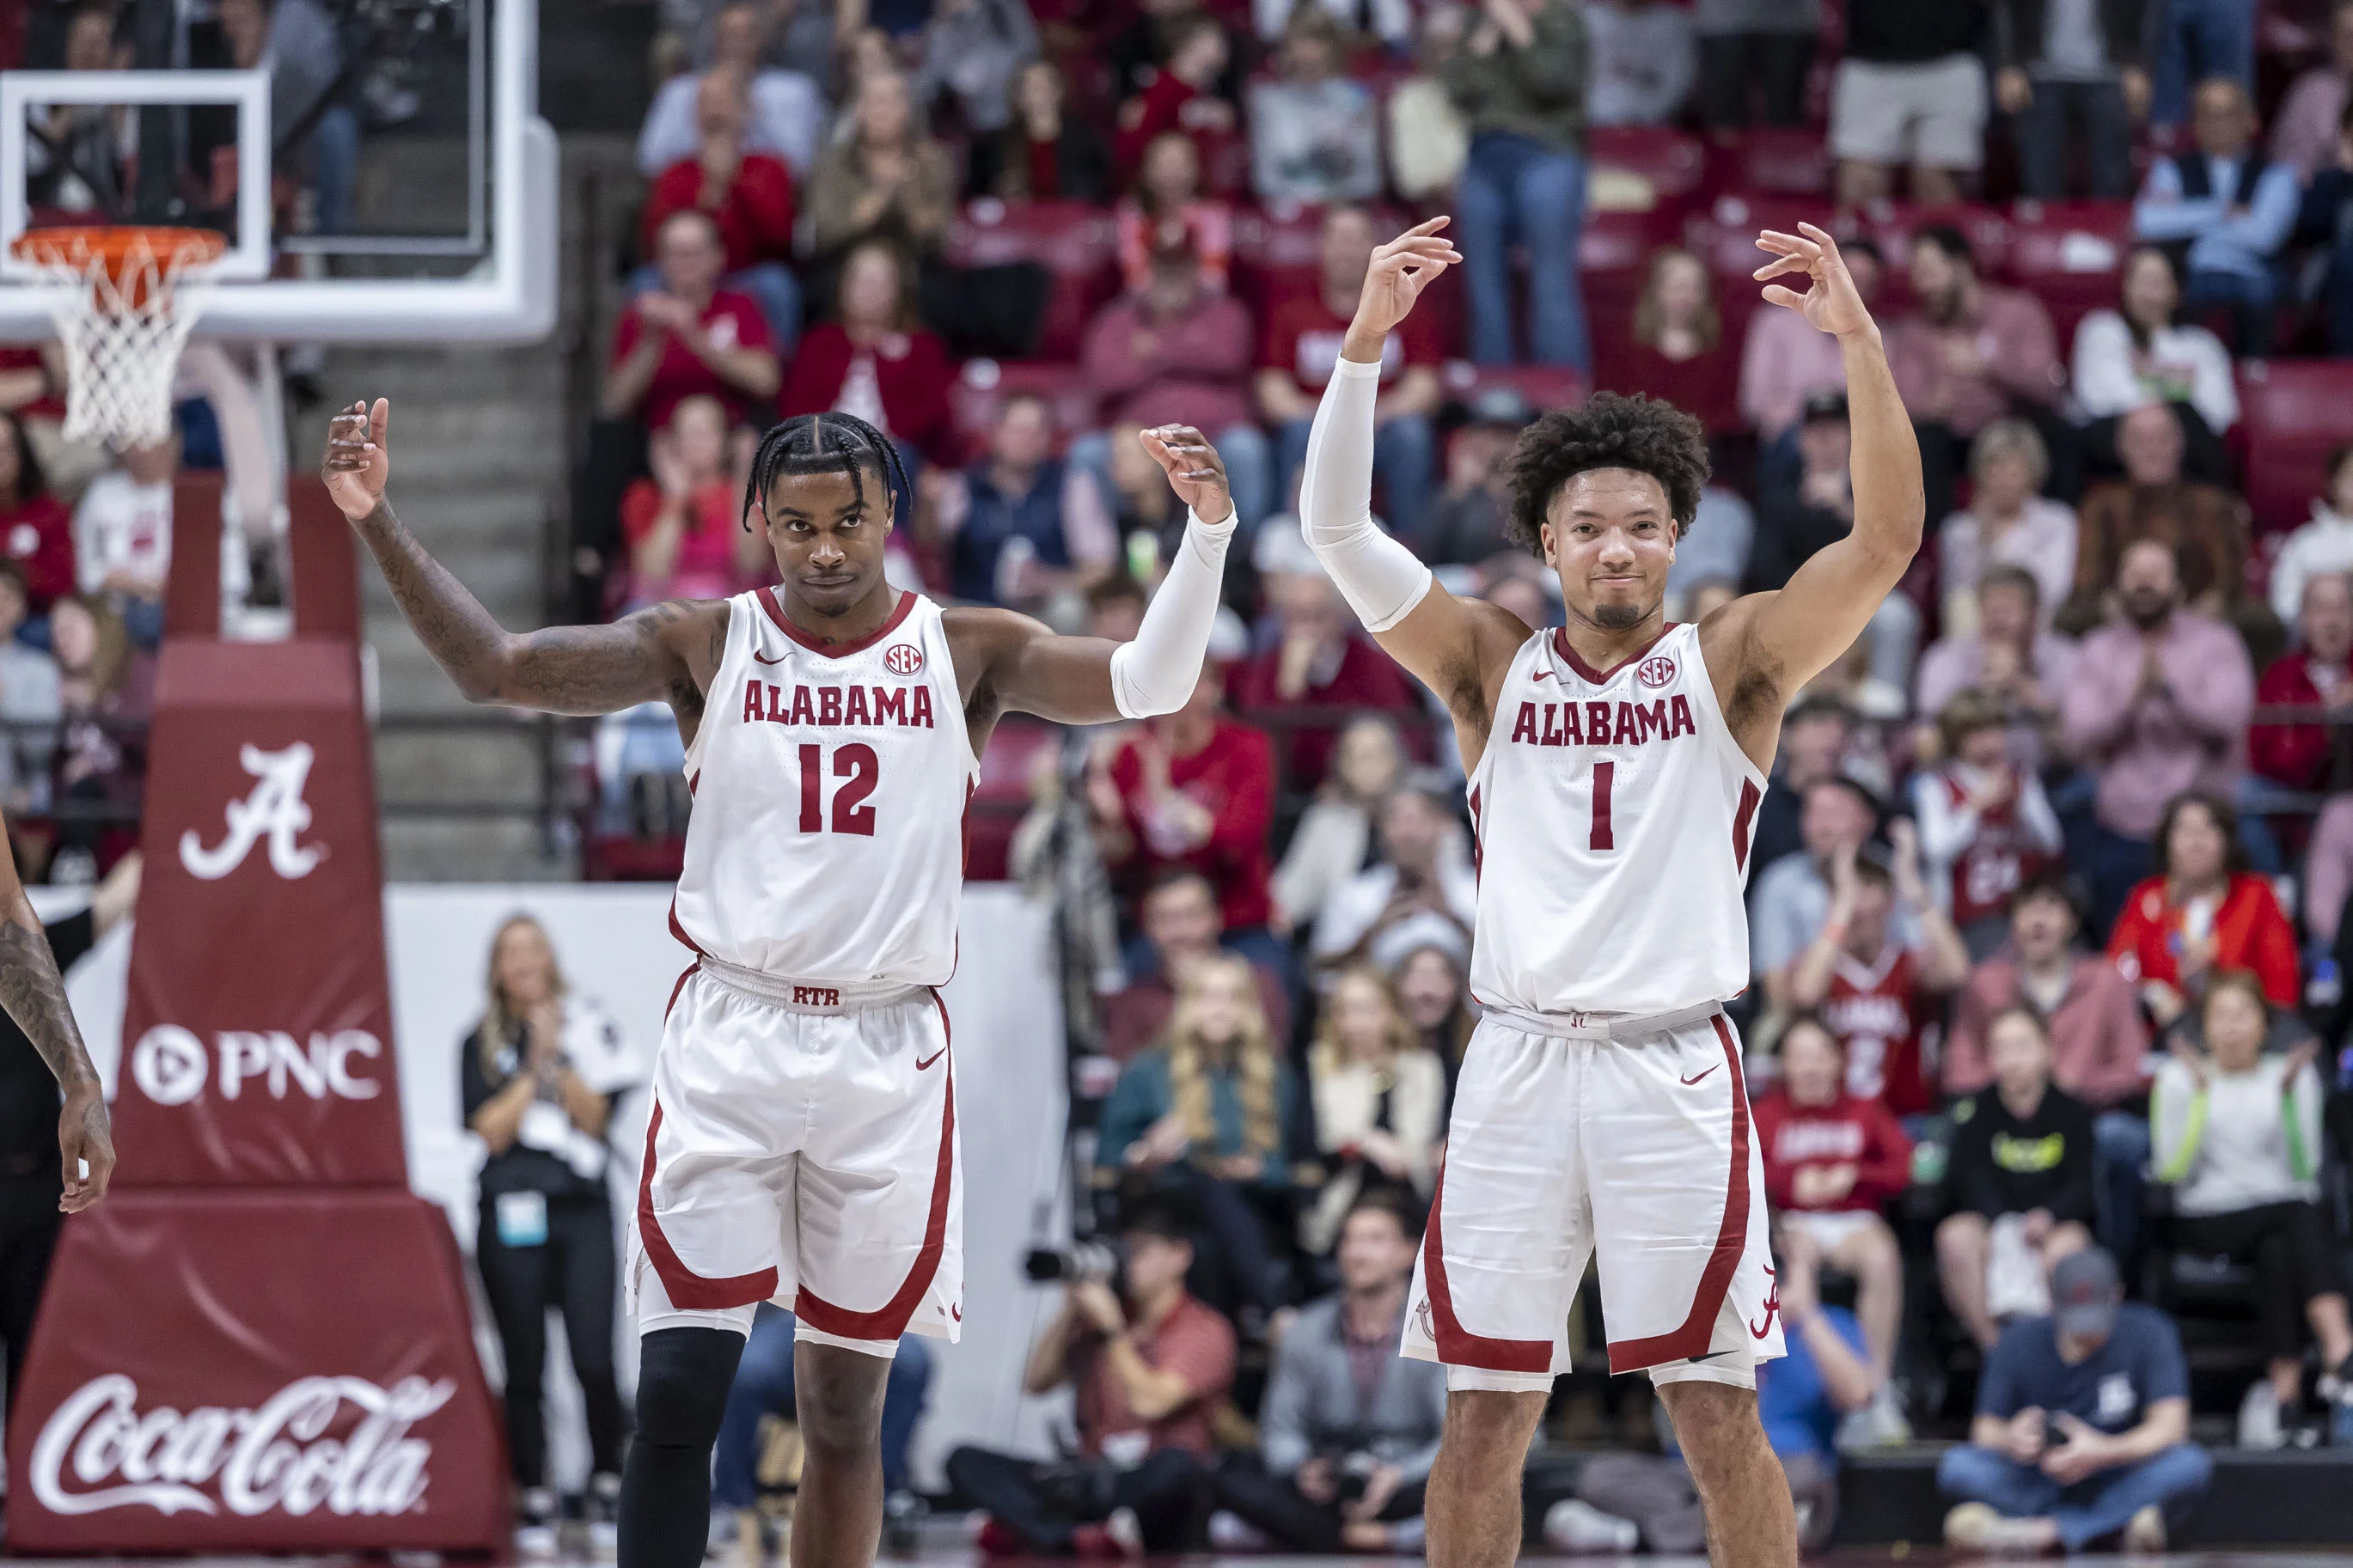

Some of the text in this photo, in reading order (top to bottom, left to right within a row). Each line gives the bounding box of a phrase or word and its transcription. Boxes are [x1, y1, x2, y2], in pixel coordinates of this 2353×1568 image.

[888, 645, 920, 673] SEC
[1640, 657, 1673, 686] SEC
[743, 680, 934, 729] ALABAMA
[1512, 694, 1696, 747] ALABAMA
[179, 741, 322, 880] A
[799, 743, 879, 836] 12
[1589, 761, 1615, 851] 1
[791, 985, 840, 1007] RTR
[217, 1029, 381, 1101] PNC
[29, 1373, 456, 1516] Coca-Cola
